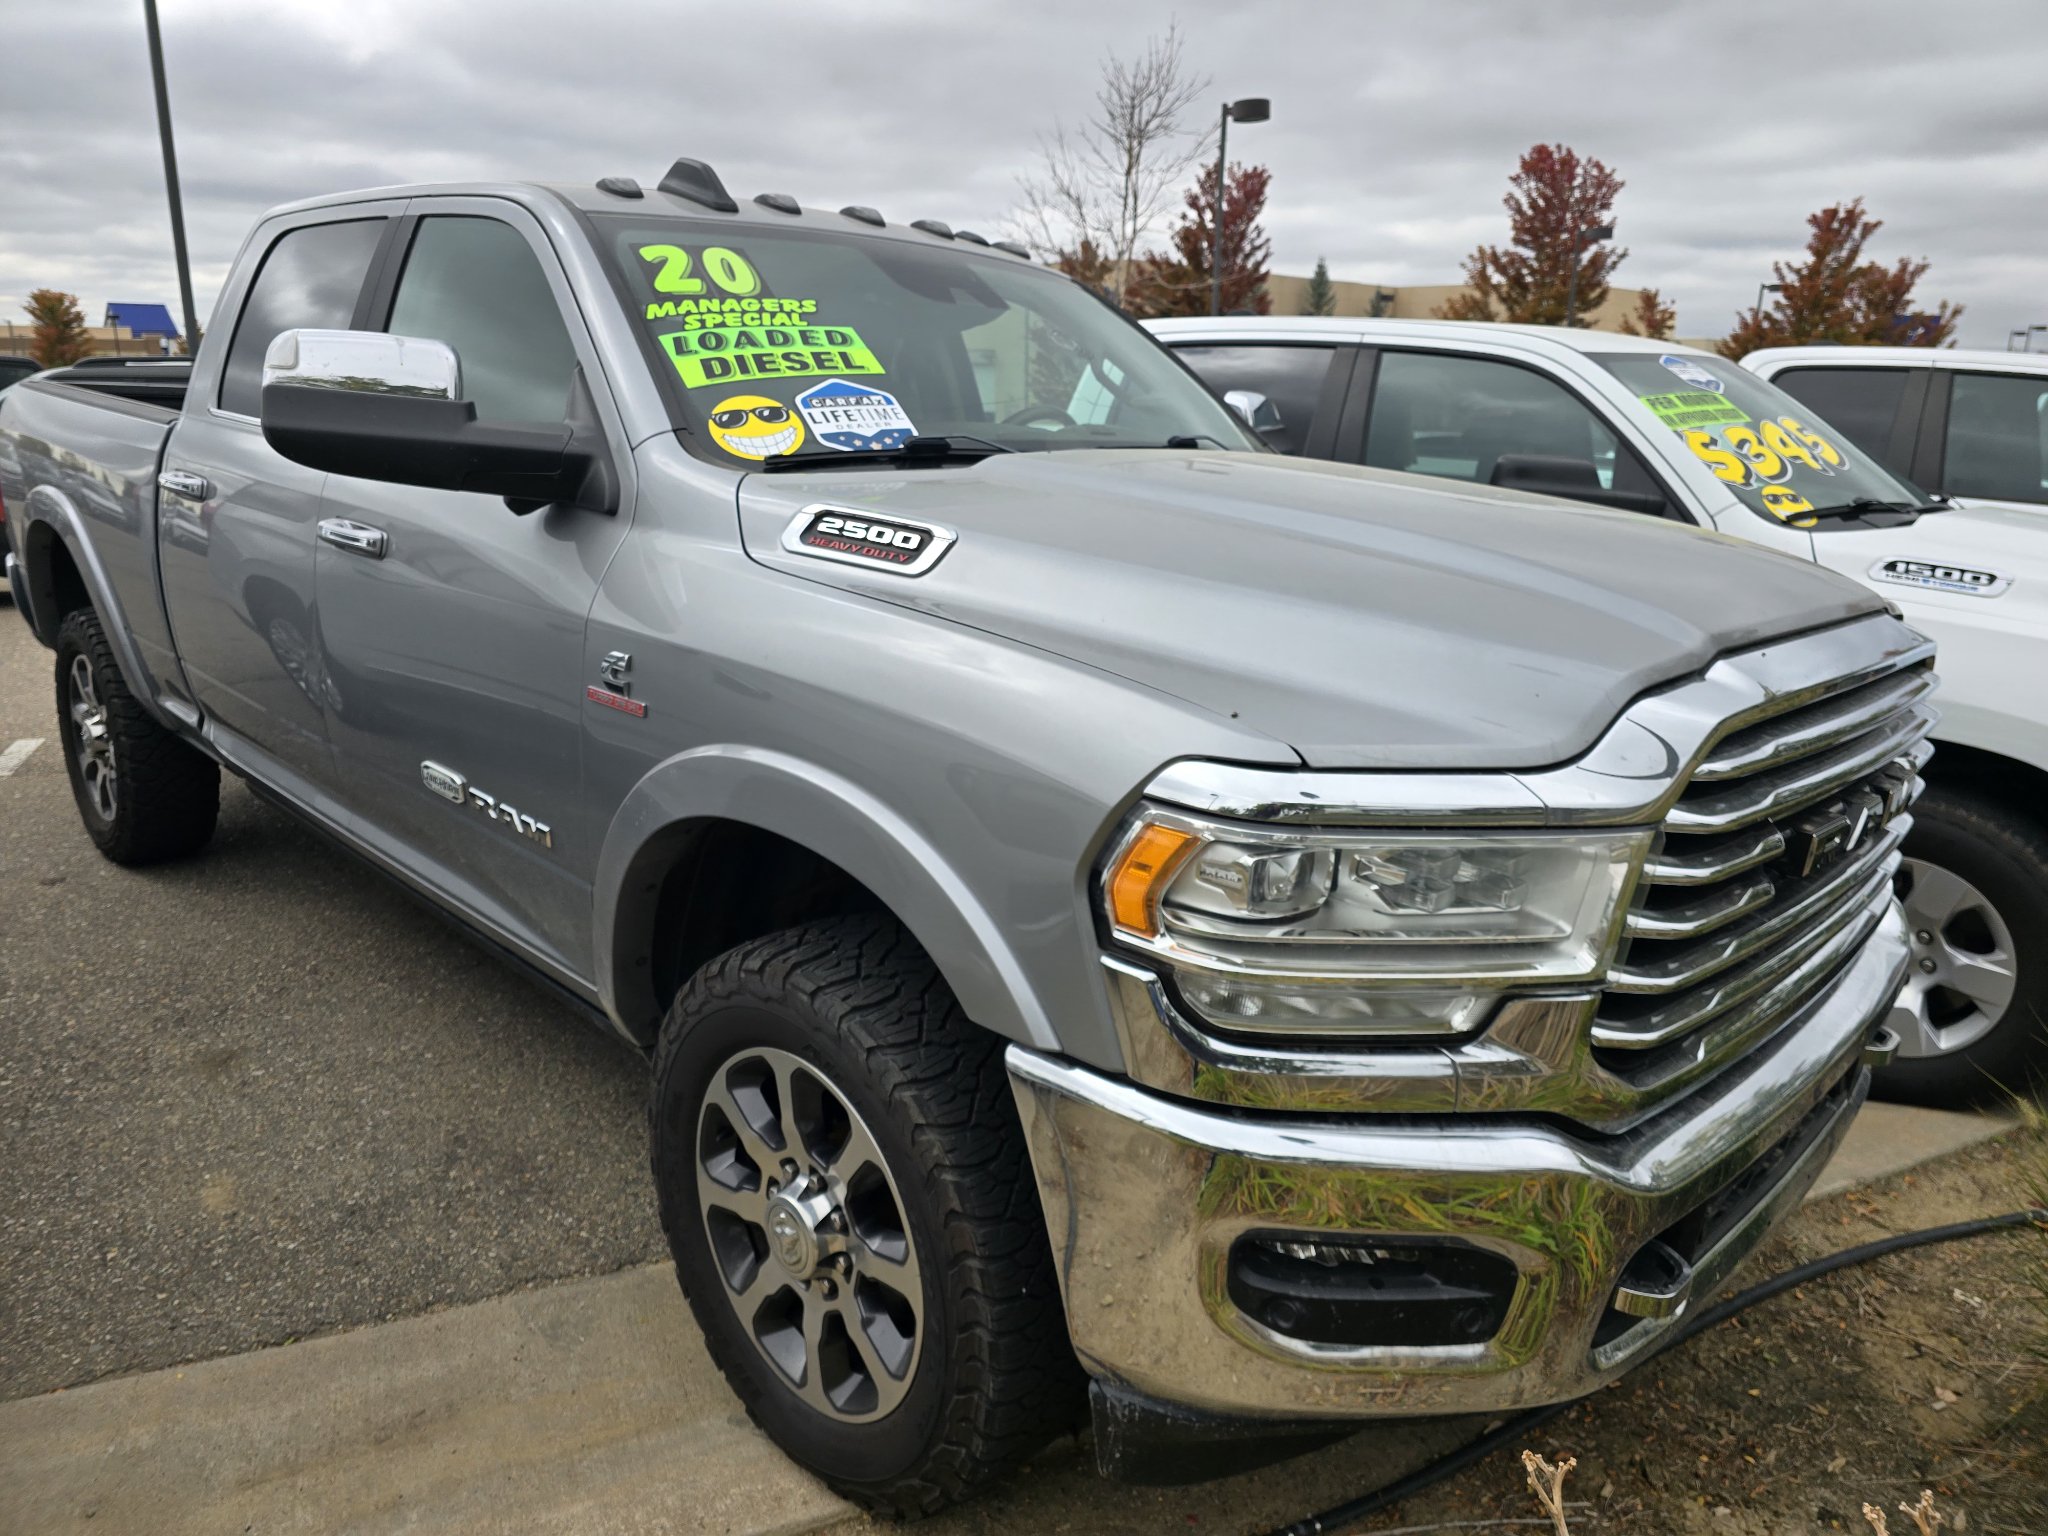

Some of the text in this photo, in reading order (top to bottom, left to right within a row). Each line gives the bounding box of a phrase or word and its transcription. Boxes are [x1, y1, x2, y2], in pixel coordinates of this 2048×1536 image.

[639, 245, 761, 296] 20
[646, 298, 817, 320] MANAGERS
[683, 312, 808, 331] SPECIAL
[672, 330, 854, 356] LOADED
[700, 351, 870, 381] DIESEL
[809, 396, 887, 408] CARFAX
[807, 407, 905, 425] LIFETIME
[816, 517, 922, 550] 2500
[808, 536, 910, 562] HEAVY DUTY
[1895, 561, 1993, 587] 1500
